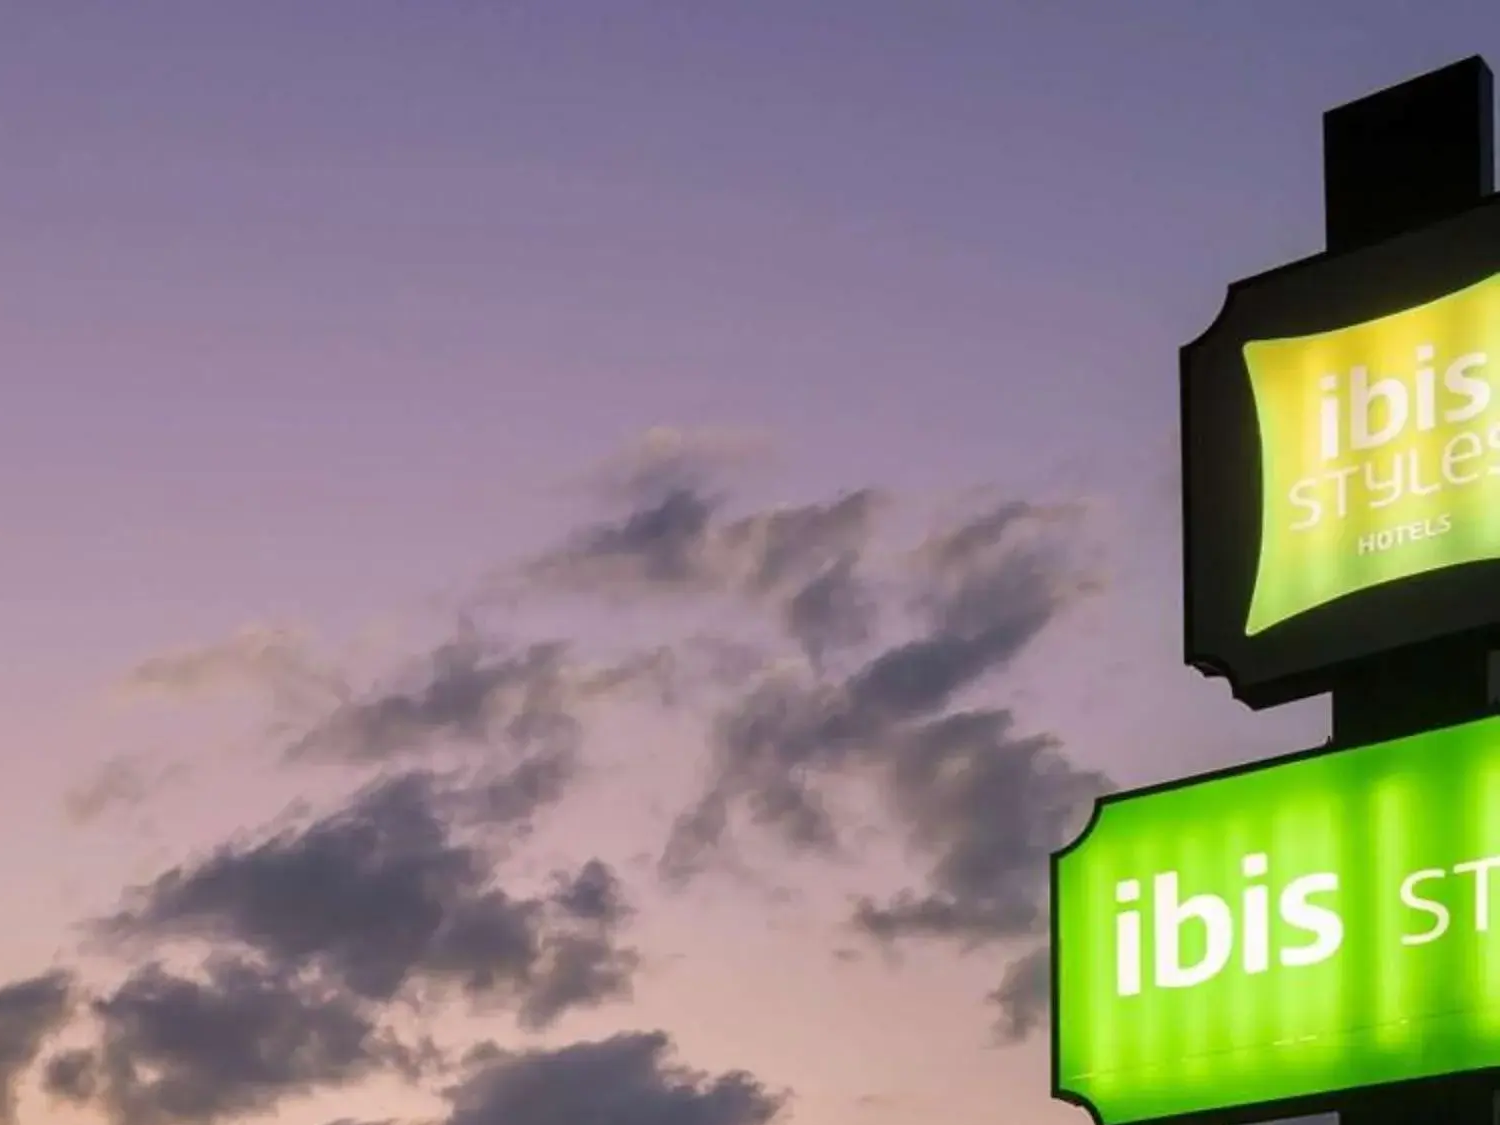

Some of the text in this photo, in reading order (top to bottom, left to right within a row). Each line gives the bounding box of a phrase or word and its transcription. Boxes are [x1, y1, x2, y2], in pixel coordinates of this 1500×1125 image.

[1318, 344, 1492, 461] ibis
[1357, 514, 1453, 557] HOTELS
[1115, 852, 1345, 997] ibis
